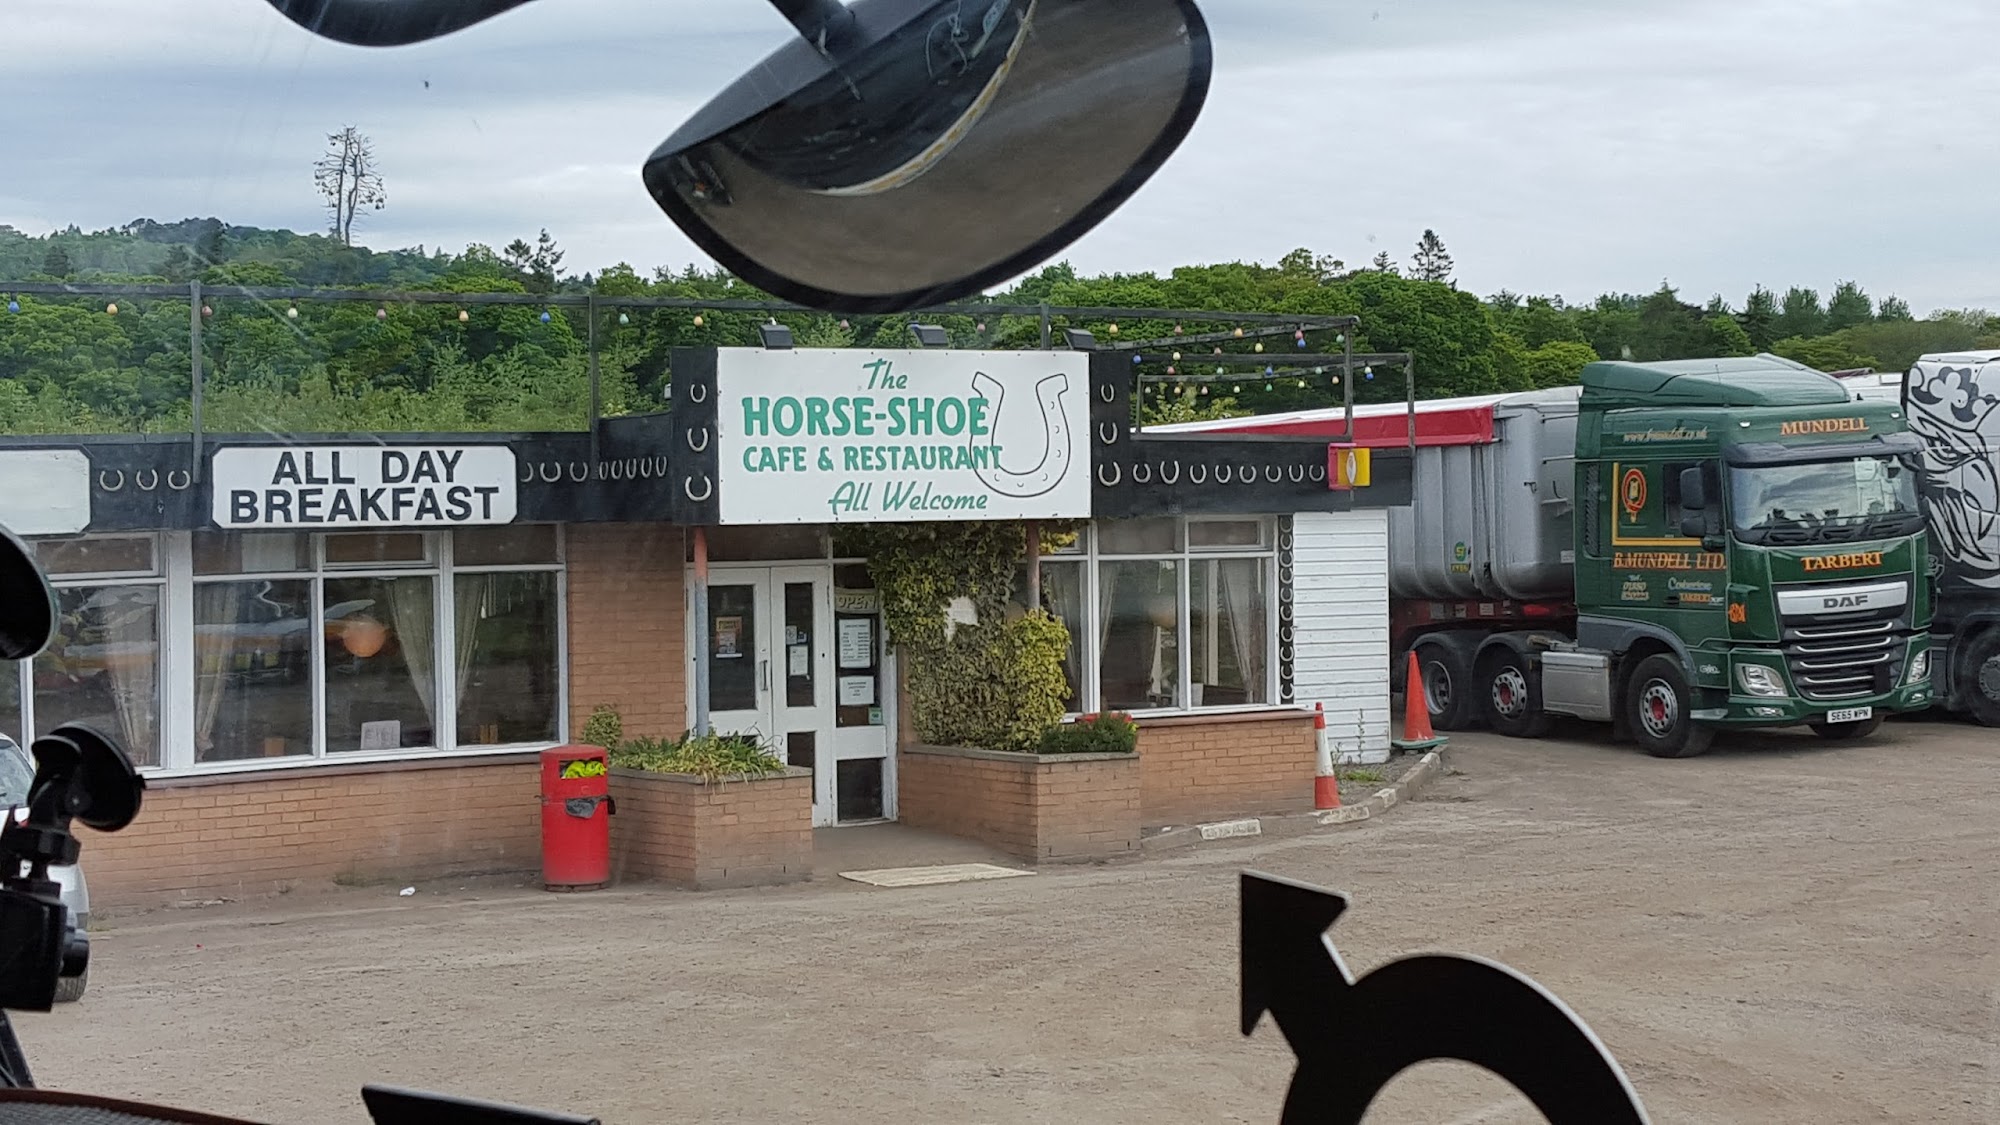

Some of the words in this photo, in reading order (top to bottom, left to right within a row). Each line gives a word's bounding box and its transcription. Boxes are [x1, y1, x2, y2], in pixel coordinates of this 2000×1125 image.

[862, 358, 908, 390] The
[742, 397, 989, 436] HORSE-SHOE
[1780, 417, 1870, 436] MUNDELL
[271, 451, 355, 485] ALL
[381, 450, 463, 484] DAY
[743, 446, 807, 472] CAFE
[817, 447, 834, 471] &
[844, 446, 1003, 471] RESTAURANT
[230, 486, 499, 524] BREAKFAST
[828, 481, 873, 515] All
[882, 481, 988, 512] Welcome
[1801, 552, 1883, 572] TARBERT
[1823, 595, 1868, 608] DAF
